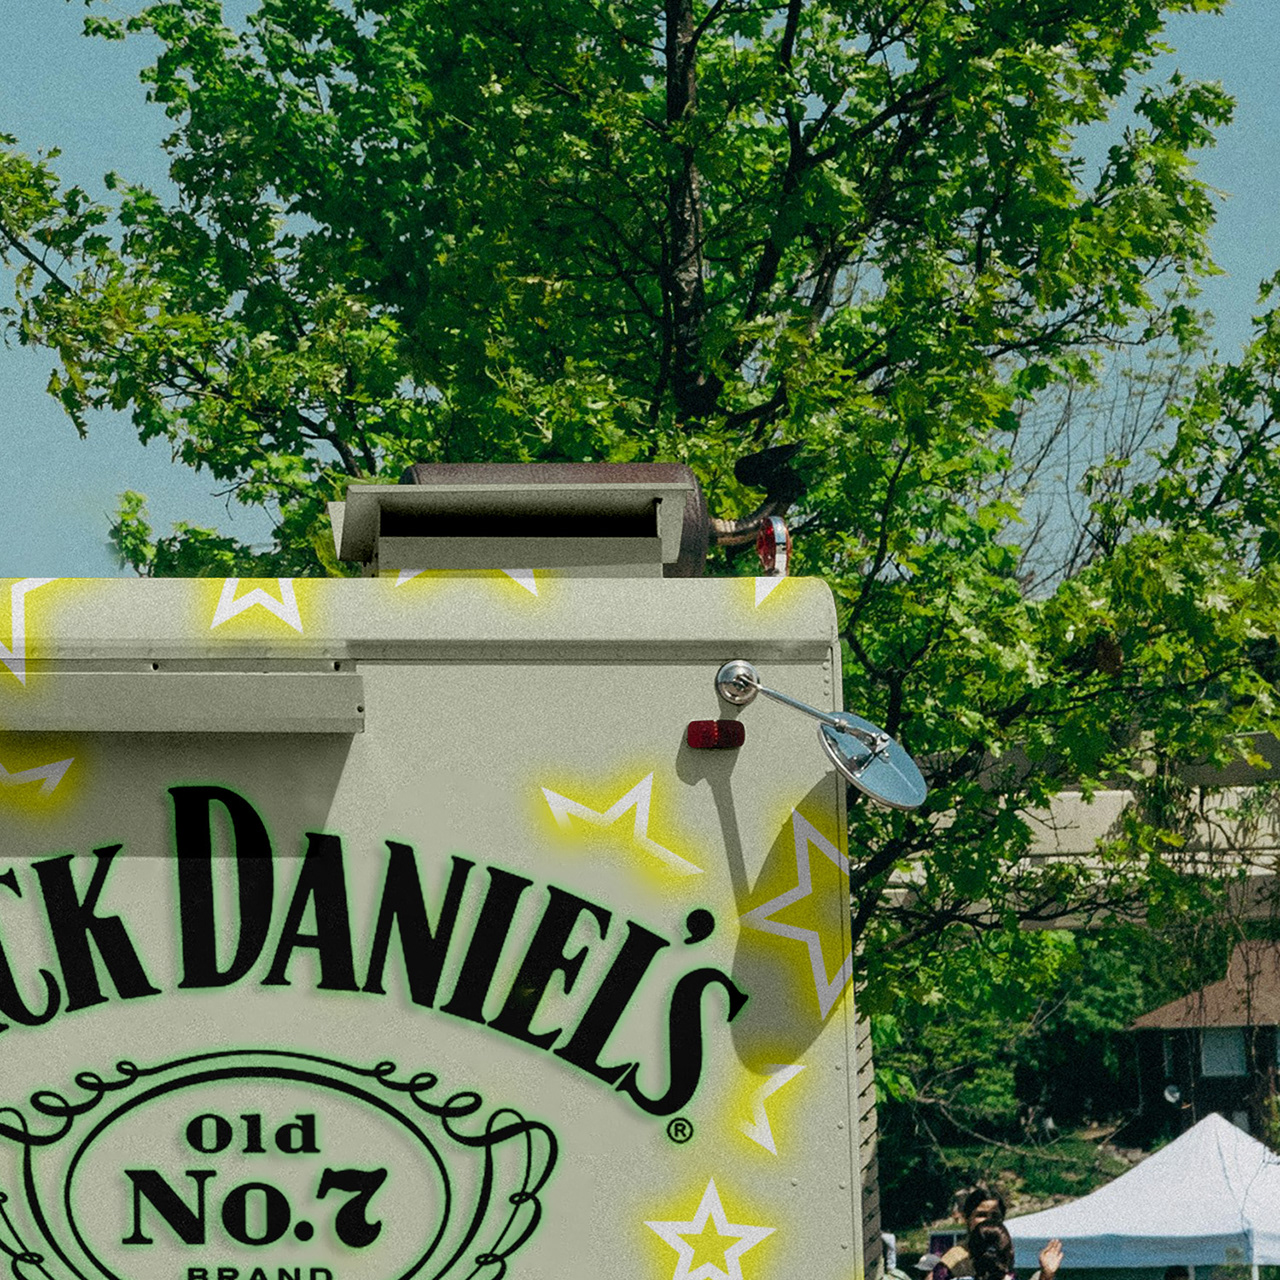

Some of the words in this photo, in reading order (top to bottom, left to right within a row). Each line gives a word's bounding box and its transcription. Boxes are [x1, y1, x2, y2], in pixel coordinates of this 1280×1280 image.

[166, 785, 749, 1116] DANIEL'S
[185, 1112, 321, 1155] Old
[121, 1167, 389, 1249] No.7
